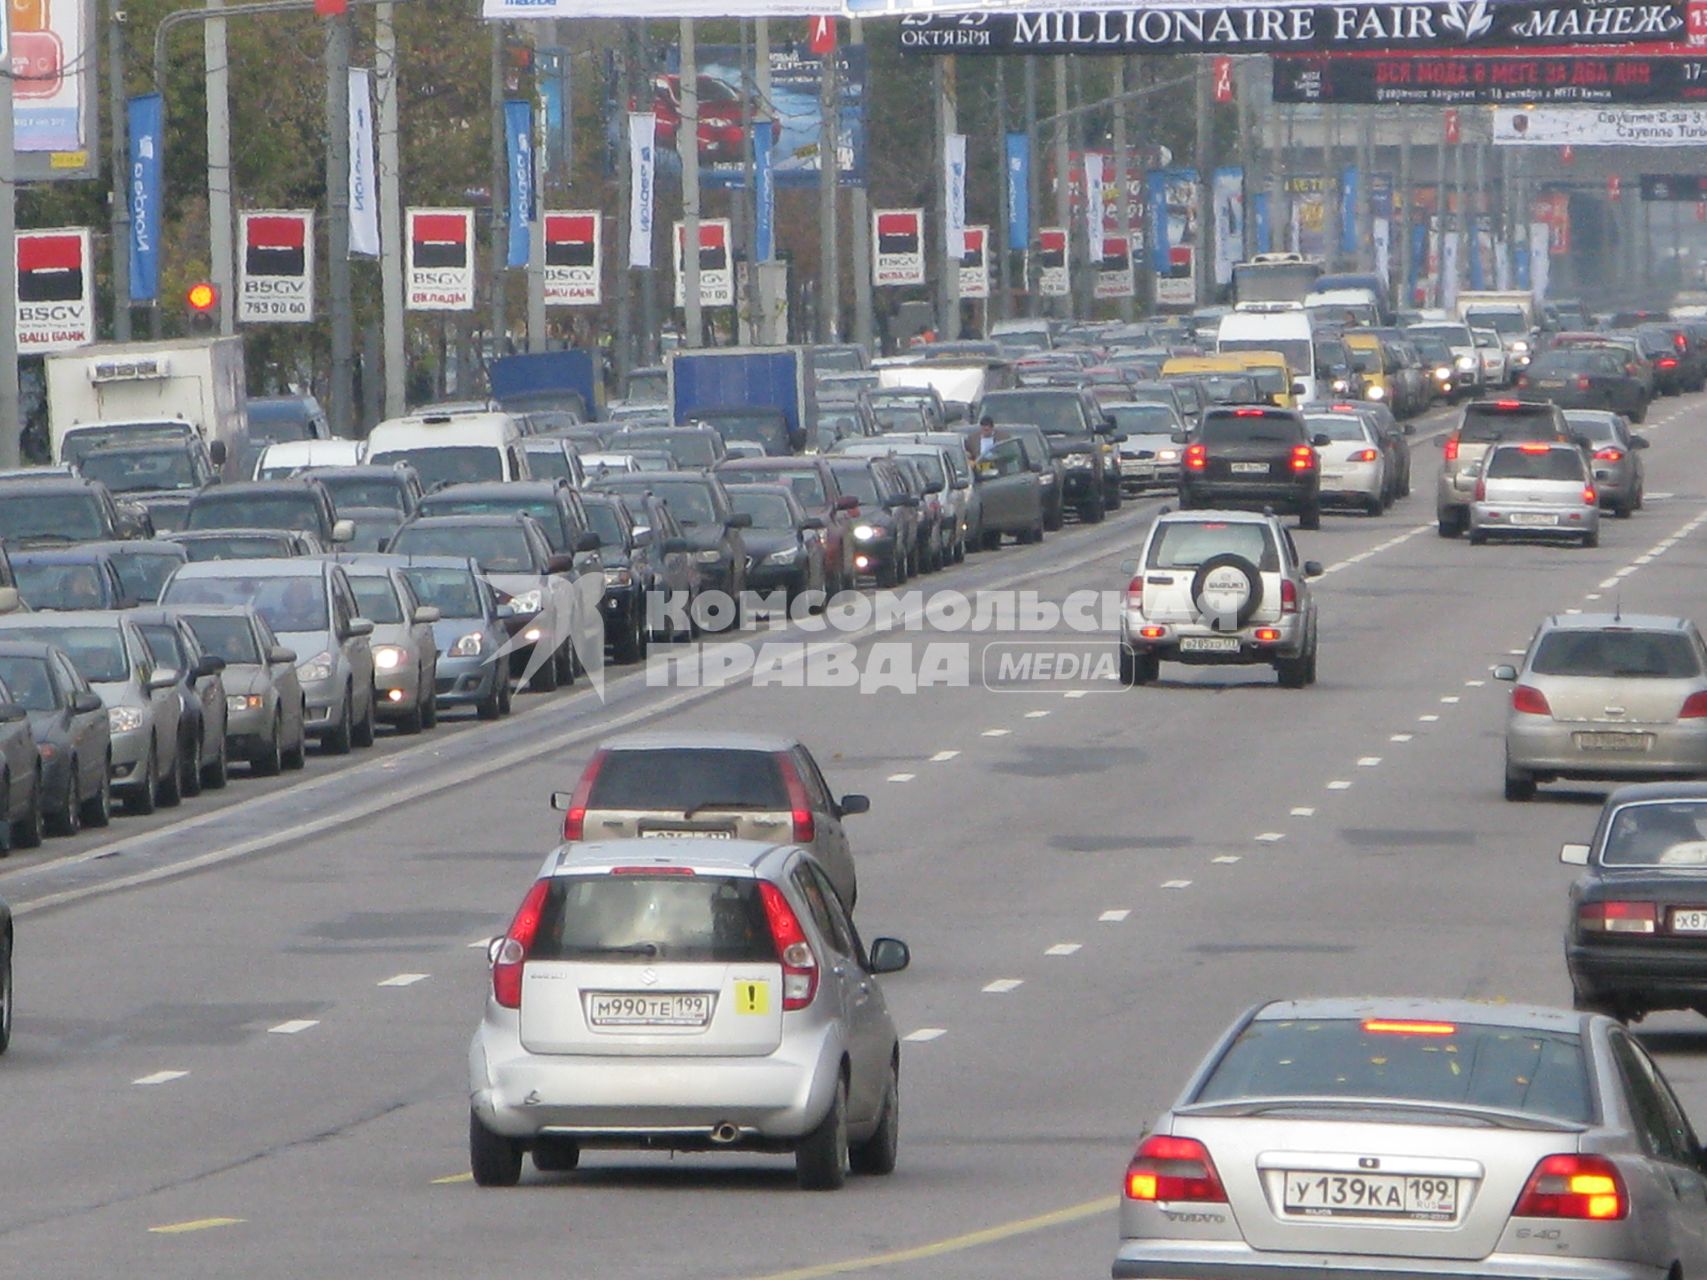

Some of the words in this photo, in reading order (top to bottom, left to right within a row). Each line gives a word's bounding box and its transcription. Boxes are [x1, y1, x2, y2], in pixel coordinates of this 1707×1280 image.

[1013, 8, 1315, 44] MILLIONAIRE
[1334, 6, 1437, 40] FAIR
[1511, 5, 1684, 37] «МАНЕЖ»
[901, 29, 990, 46] ОКТЯБРЯ
[1616, 124, 1674, 139] Cayenne
[413, 272, 466, 285] BSGV
[544, 268, 595, 281] BSGV
[244, 280, 305, 293] BSGV
[18, 305, 85, 321] BSGV
[18, 331, 49, 344] ВАШ
[51, 330, 86, 343] БАНК
[597, 998, 671, 1017] М990ТЕ
[675, 998, 703, 1012] 199
[1296, 1176, 1402, 1208] У139КА
[1409, 1179, 1449, 1201] 199
[1416, 1201, 1438, 1210] RUS
